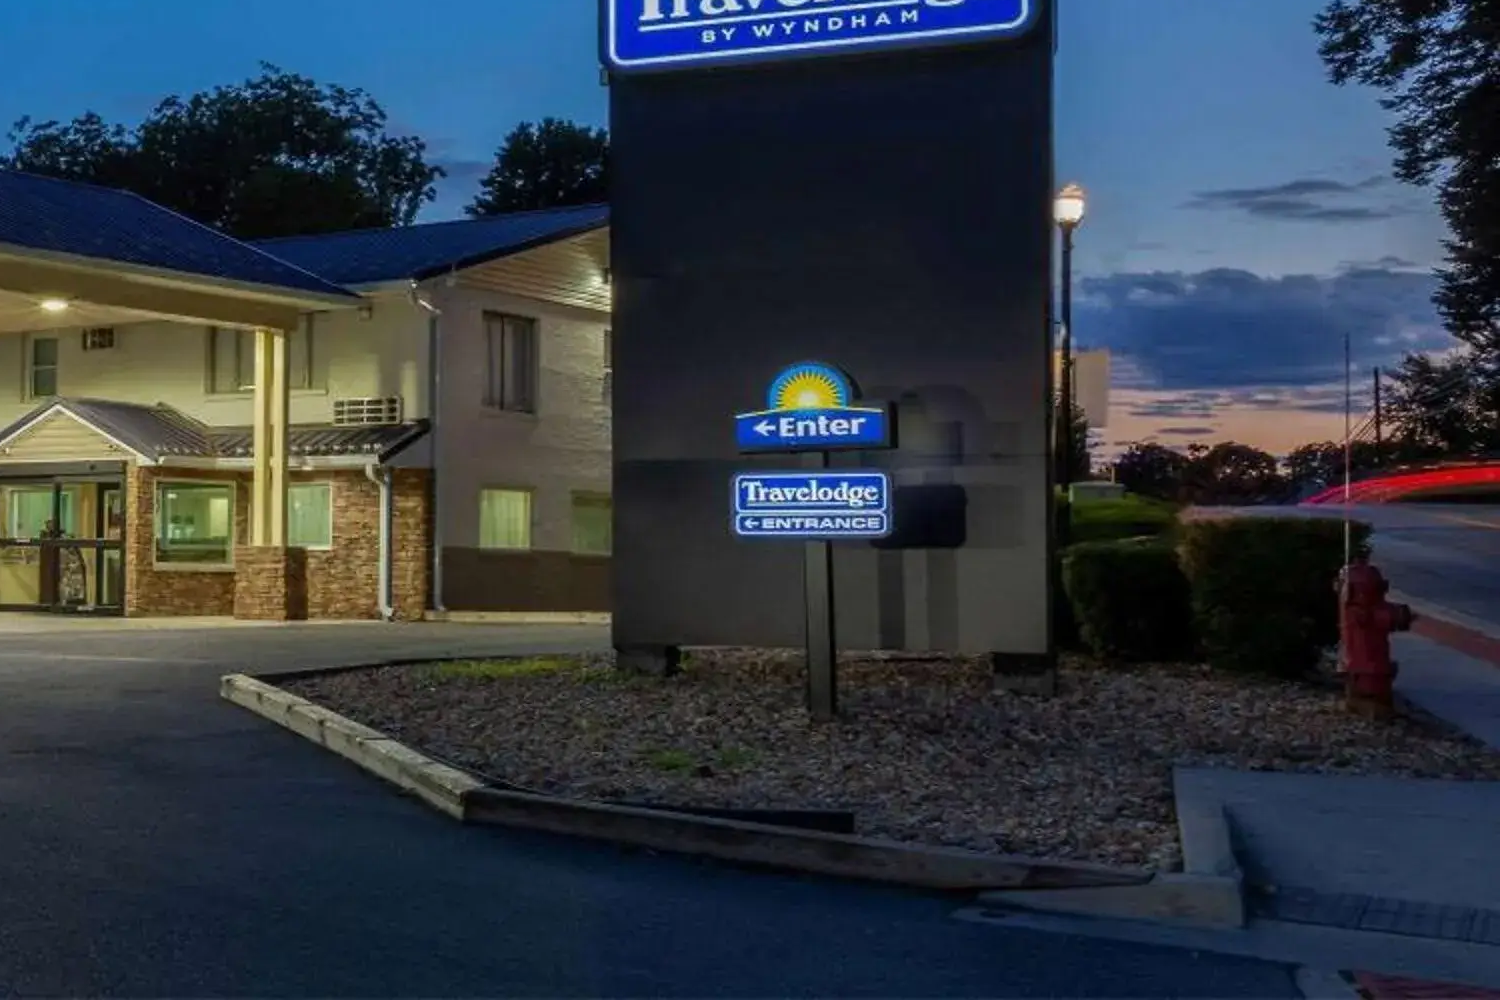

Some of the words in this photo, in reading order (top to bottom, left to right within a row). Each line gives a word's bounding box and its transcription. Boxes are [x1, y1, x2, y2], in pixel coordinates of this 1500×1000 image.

[701, 27, 738, 44] BY
[752, 8, 919, 39] WYNDHAM
[778, 415, 868, 438] Enter
[741, 479, 879, 508] Travelodge
[761, 517, 881, 530] ENTRANCE
